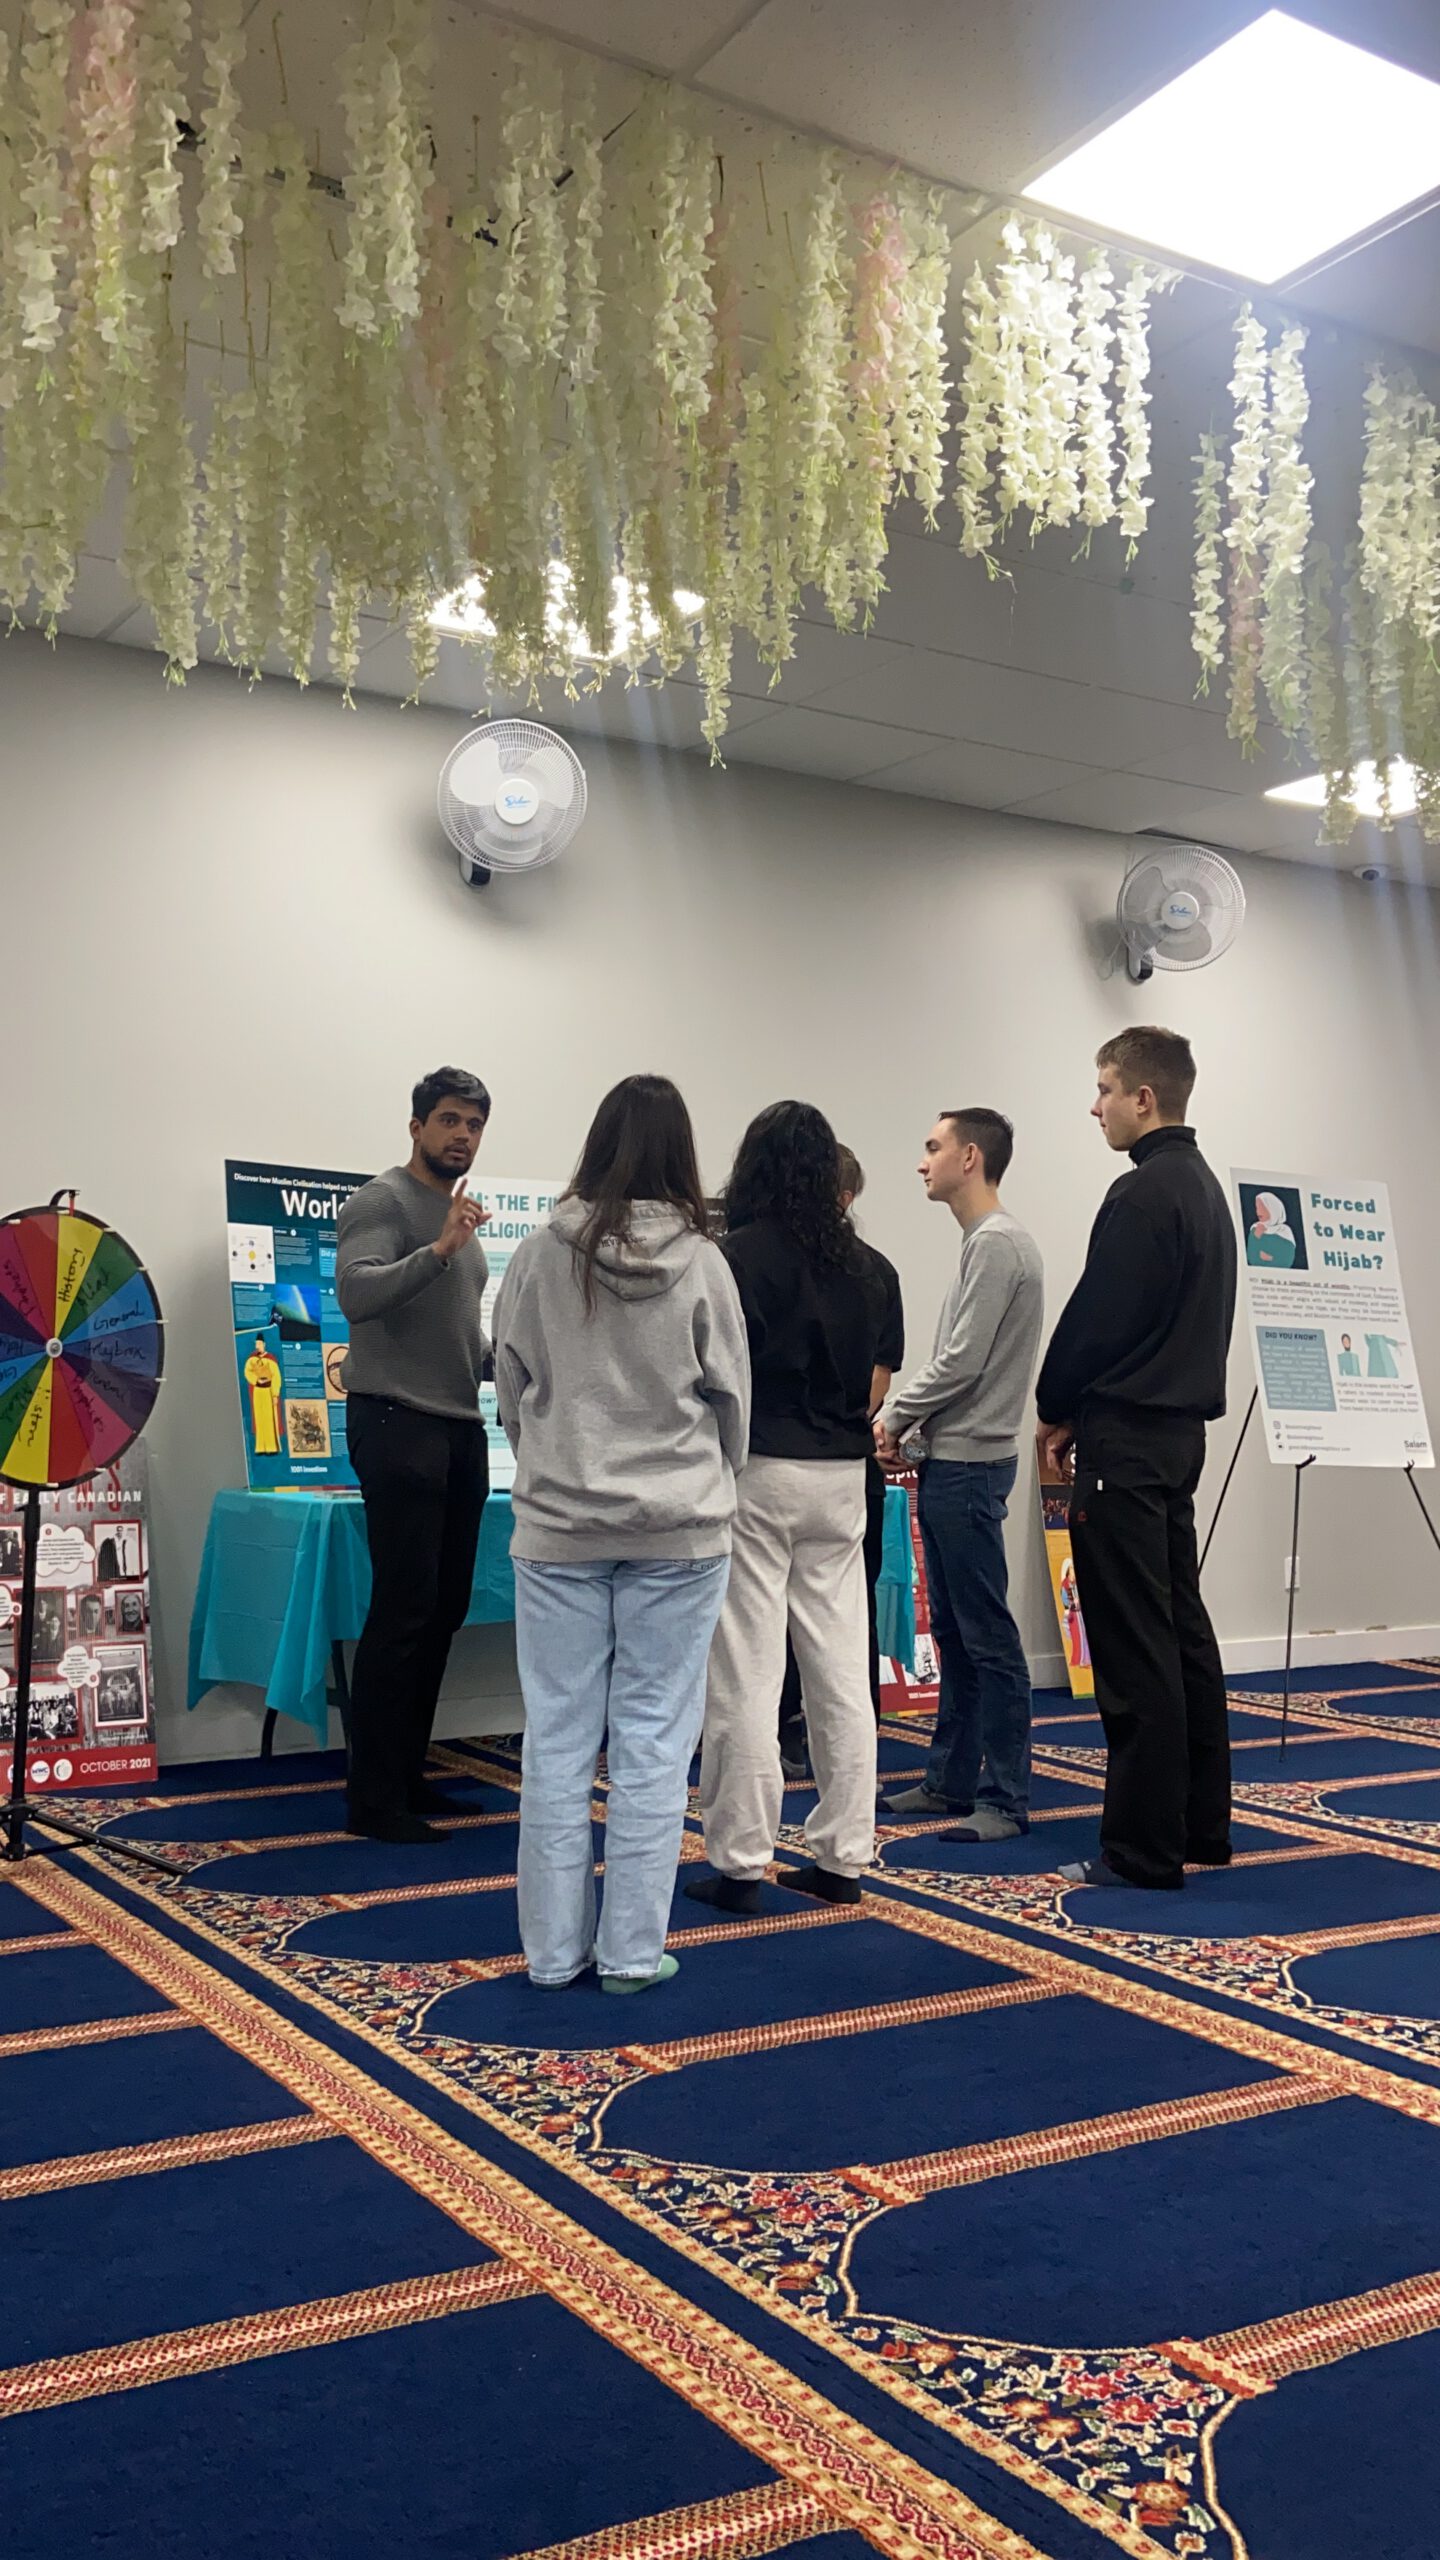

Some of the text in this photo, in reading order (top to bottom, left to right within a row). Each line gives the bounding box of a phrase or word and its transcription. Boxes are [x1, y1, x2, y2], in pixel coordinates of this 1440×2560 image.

[496, 1194, 529, 1211] THE
[537, 1197, 558, 1212] FI
[1311, 1193, 1376, 1213] Forced
[478, 1221, 537, 1239] ELIGIO
[1313, 1221, 1386, 1242] to Wear
[1323, 1251, 1383, 1271] Hijab?
[57, 1247, 86, 1303] History
[1265, 1331, 1318, 1341] DID YOU KNOW?
[13, 1490, 60, 1505] EALY
[67, 1490, 142, 1502] CANADIAN
[80, 1757, 152, 1774] OCTOBER 2021
